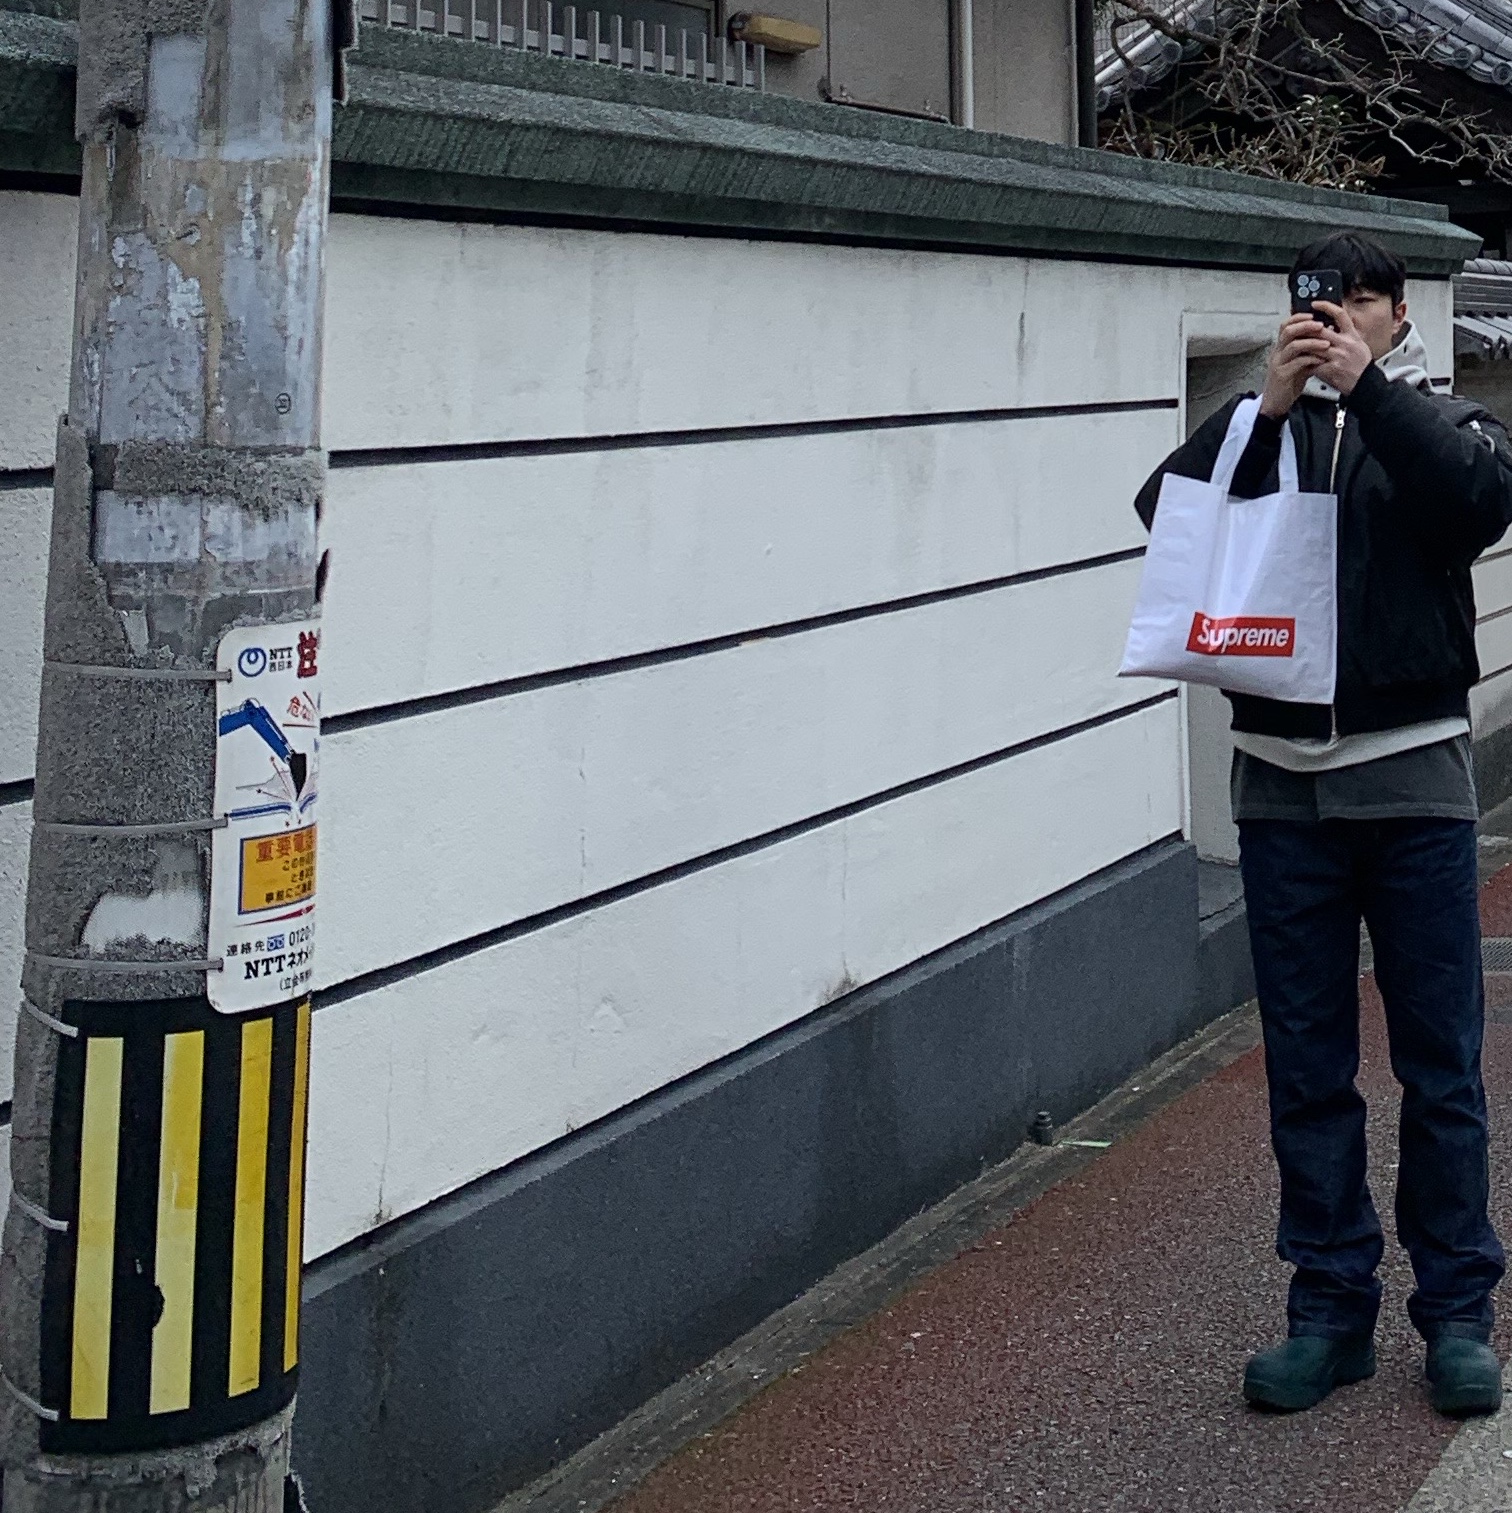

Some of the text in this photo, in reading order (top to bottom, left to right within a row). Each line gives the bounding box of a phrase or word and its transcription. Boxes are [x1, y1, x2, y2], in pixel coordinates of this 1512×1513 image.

[1197, 618, 1289, 653] Supreme
[269, 648, 293, 661] NTT
[226, 941, 266, 958] 連絡先
